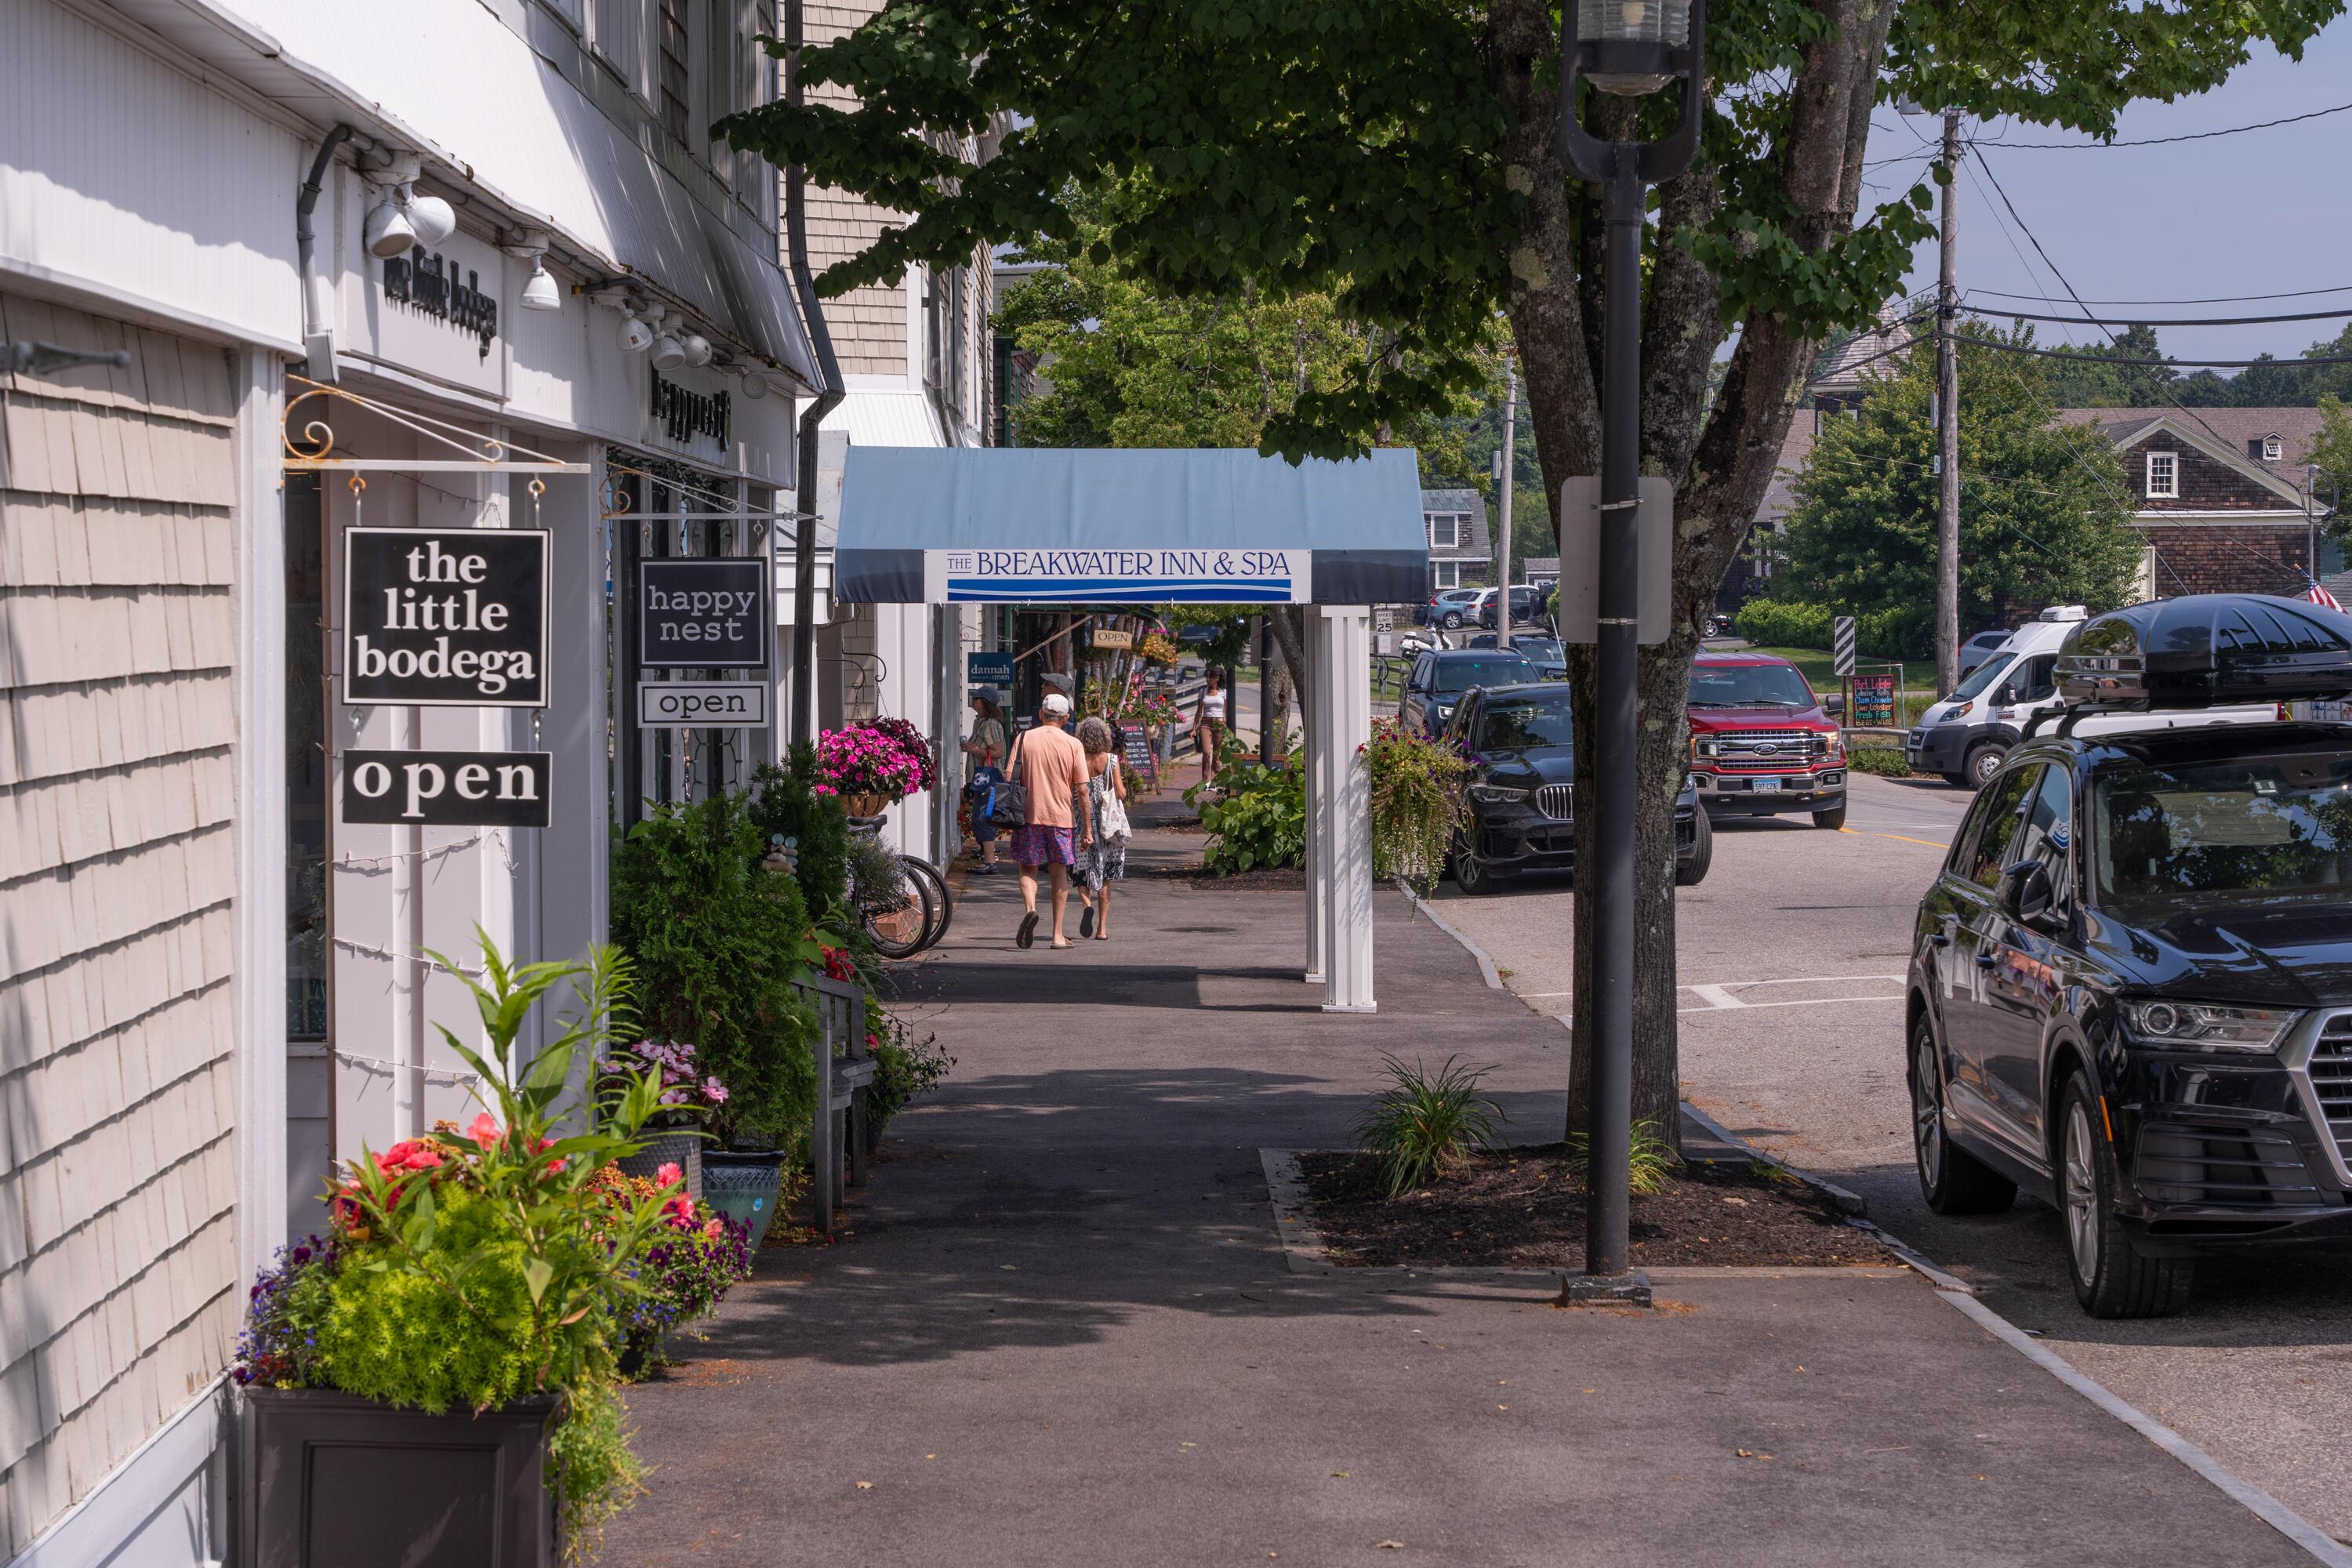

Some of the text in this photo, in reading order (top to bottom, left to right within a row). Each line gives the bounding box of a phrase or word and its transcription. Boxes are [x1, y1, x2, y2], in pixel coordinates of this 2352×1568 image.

[406, 541, 487, 583] the
[947, 551, 1291, 575] THE BREAKWATER INN & SPA
[383, 588, 509, 631] little
[648, 585, 756, 616] happy
[660, 617, 744, 641] nest
[1098, 632, 1128, 642] OPEN
[1377, 623, 1392, 633] 25
[354, 635, 536, 694] bodega
[971, 664, 1011, 675] dannah
[1854, 677, 1892, 689] Port Lobster
[659, 695, 746, 719] open
[1854, 695, 1870, 704] Clam
[1855, 710, 1873, 719] Fresh
[353, 761, 539, 818] open
